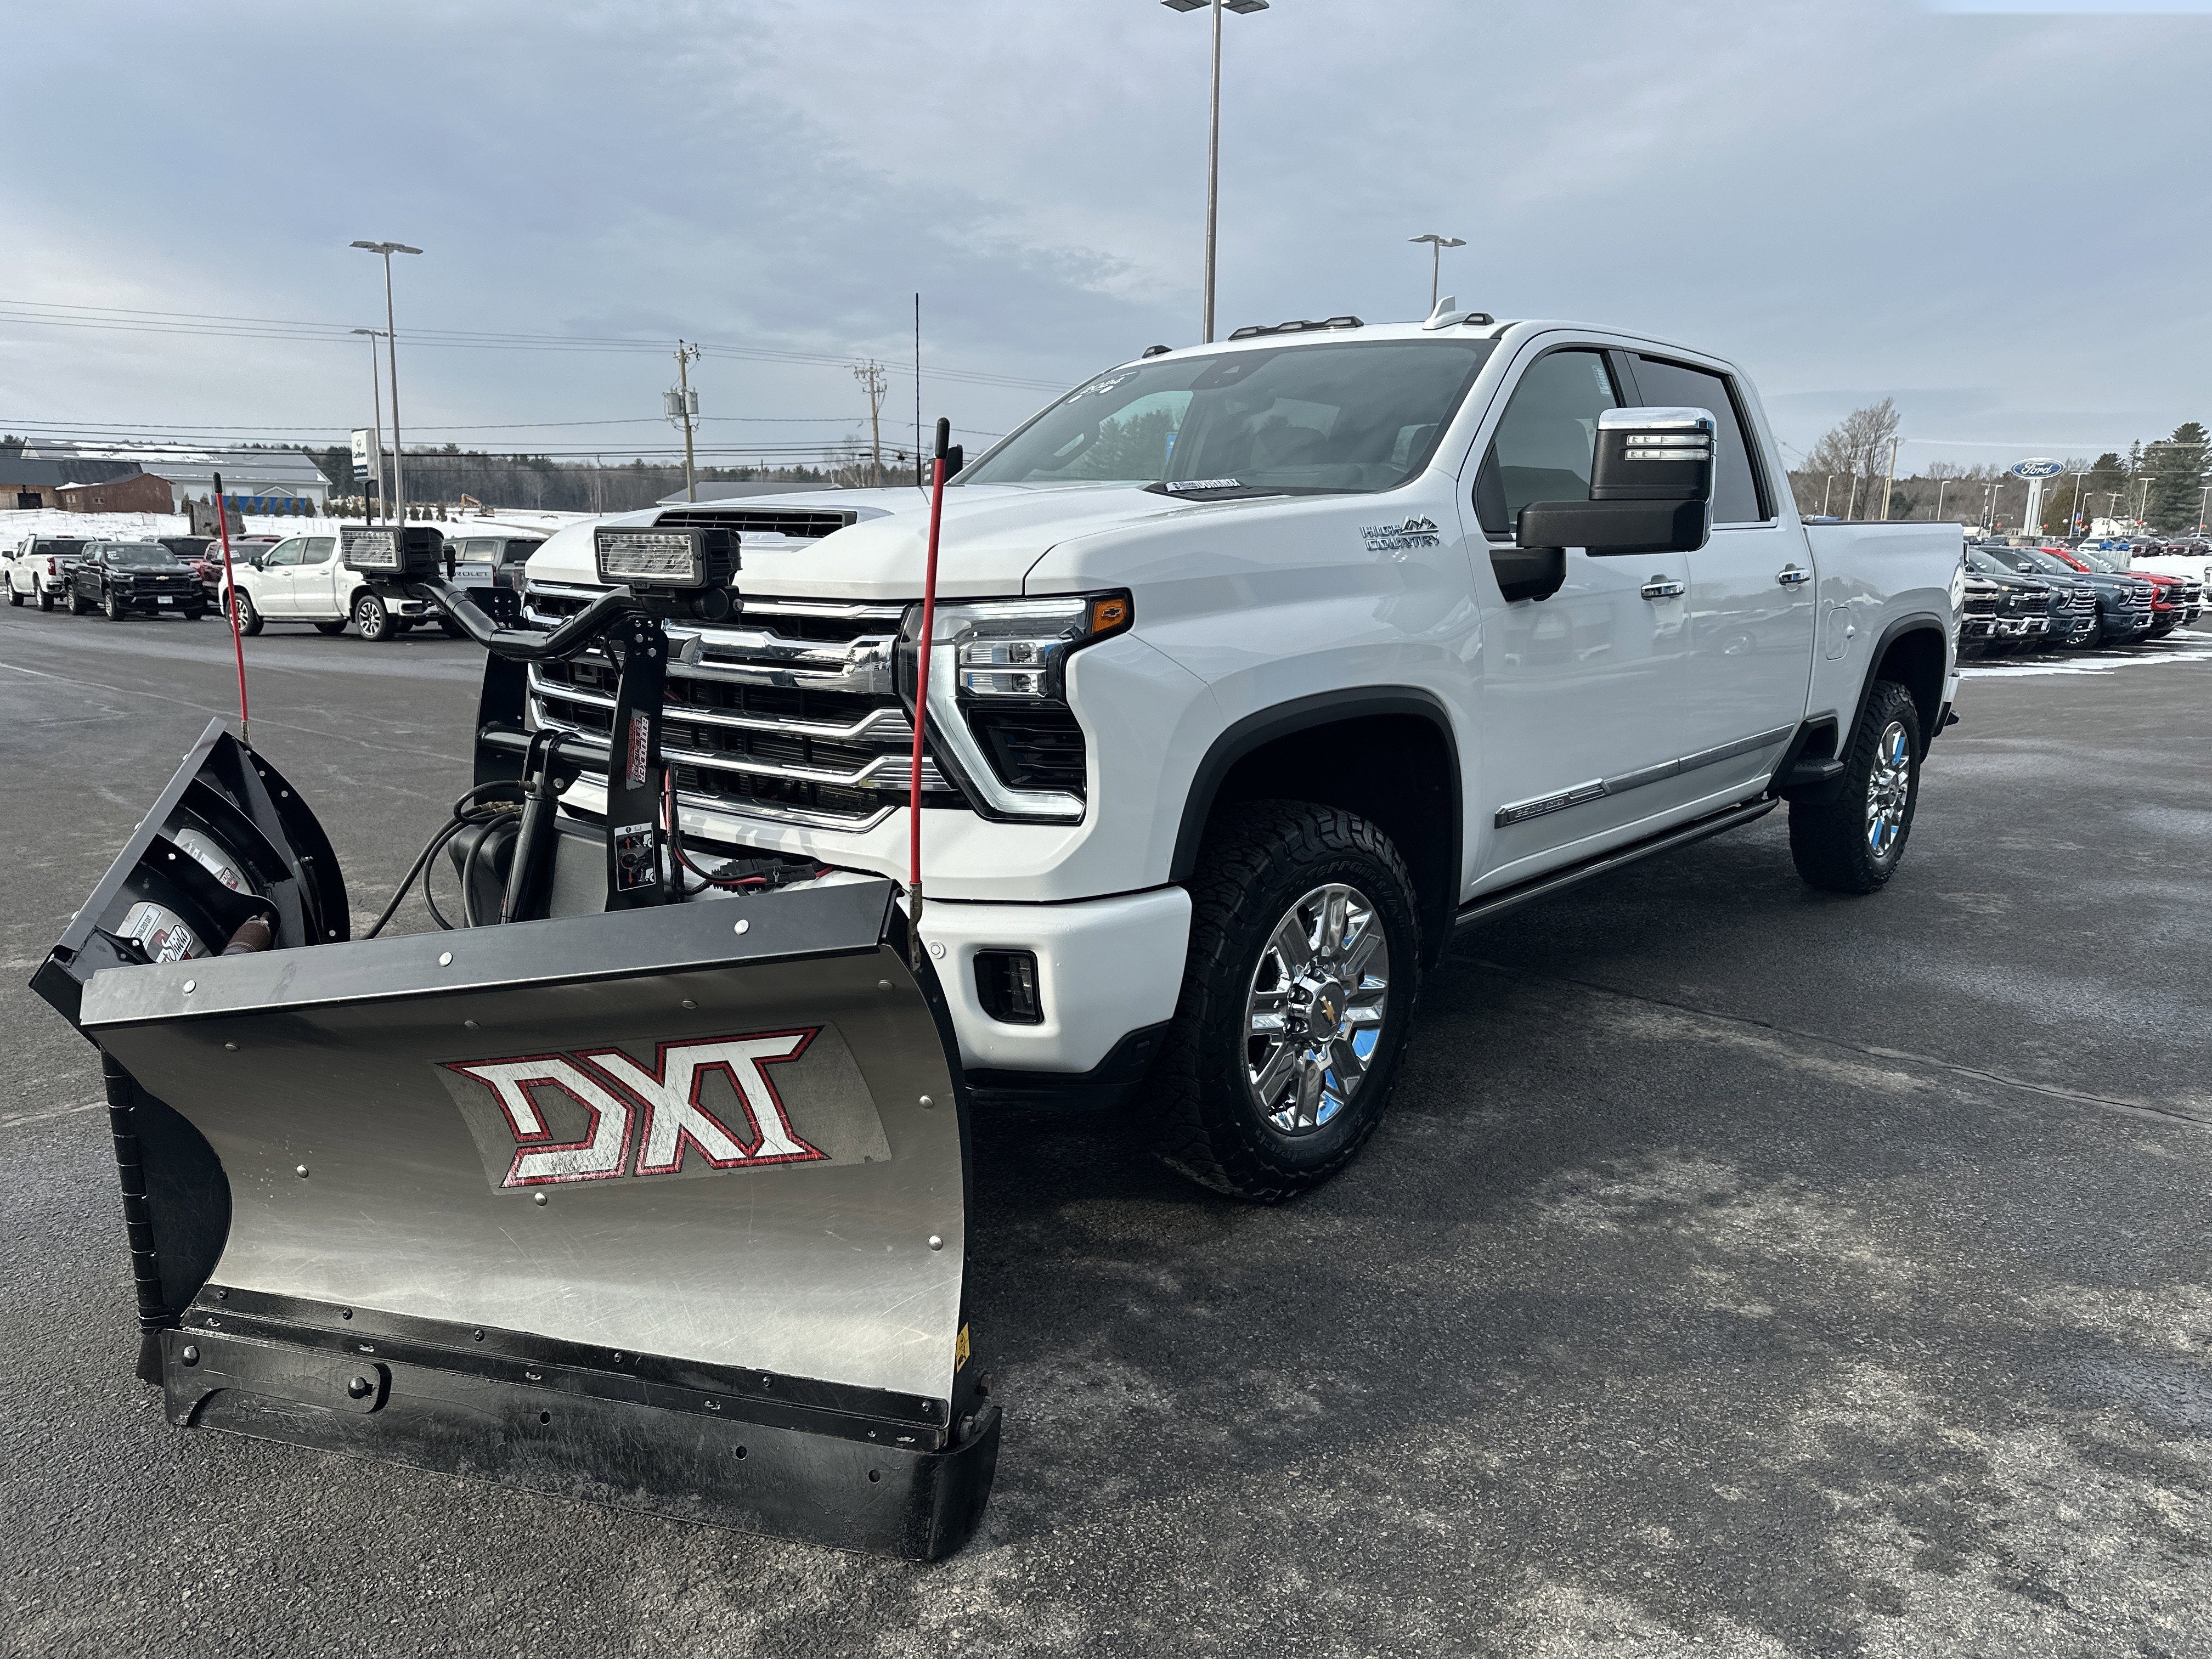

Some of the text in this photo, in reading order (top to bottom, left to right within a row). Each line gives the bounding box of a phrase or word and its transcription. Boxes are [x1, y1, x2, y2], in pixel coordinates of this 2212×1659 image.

[2021, 462, 2053, 475] Ford
[1359, 524, 1402, 539] HIGH
[1364, 534, 1440, 551] COUNTRY
[435, 1025, 832, 1188] DXT
